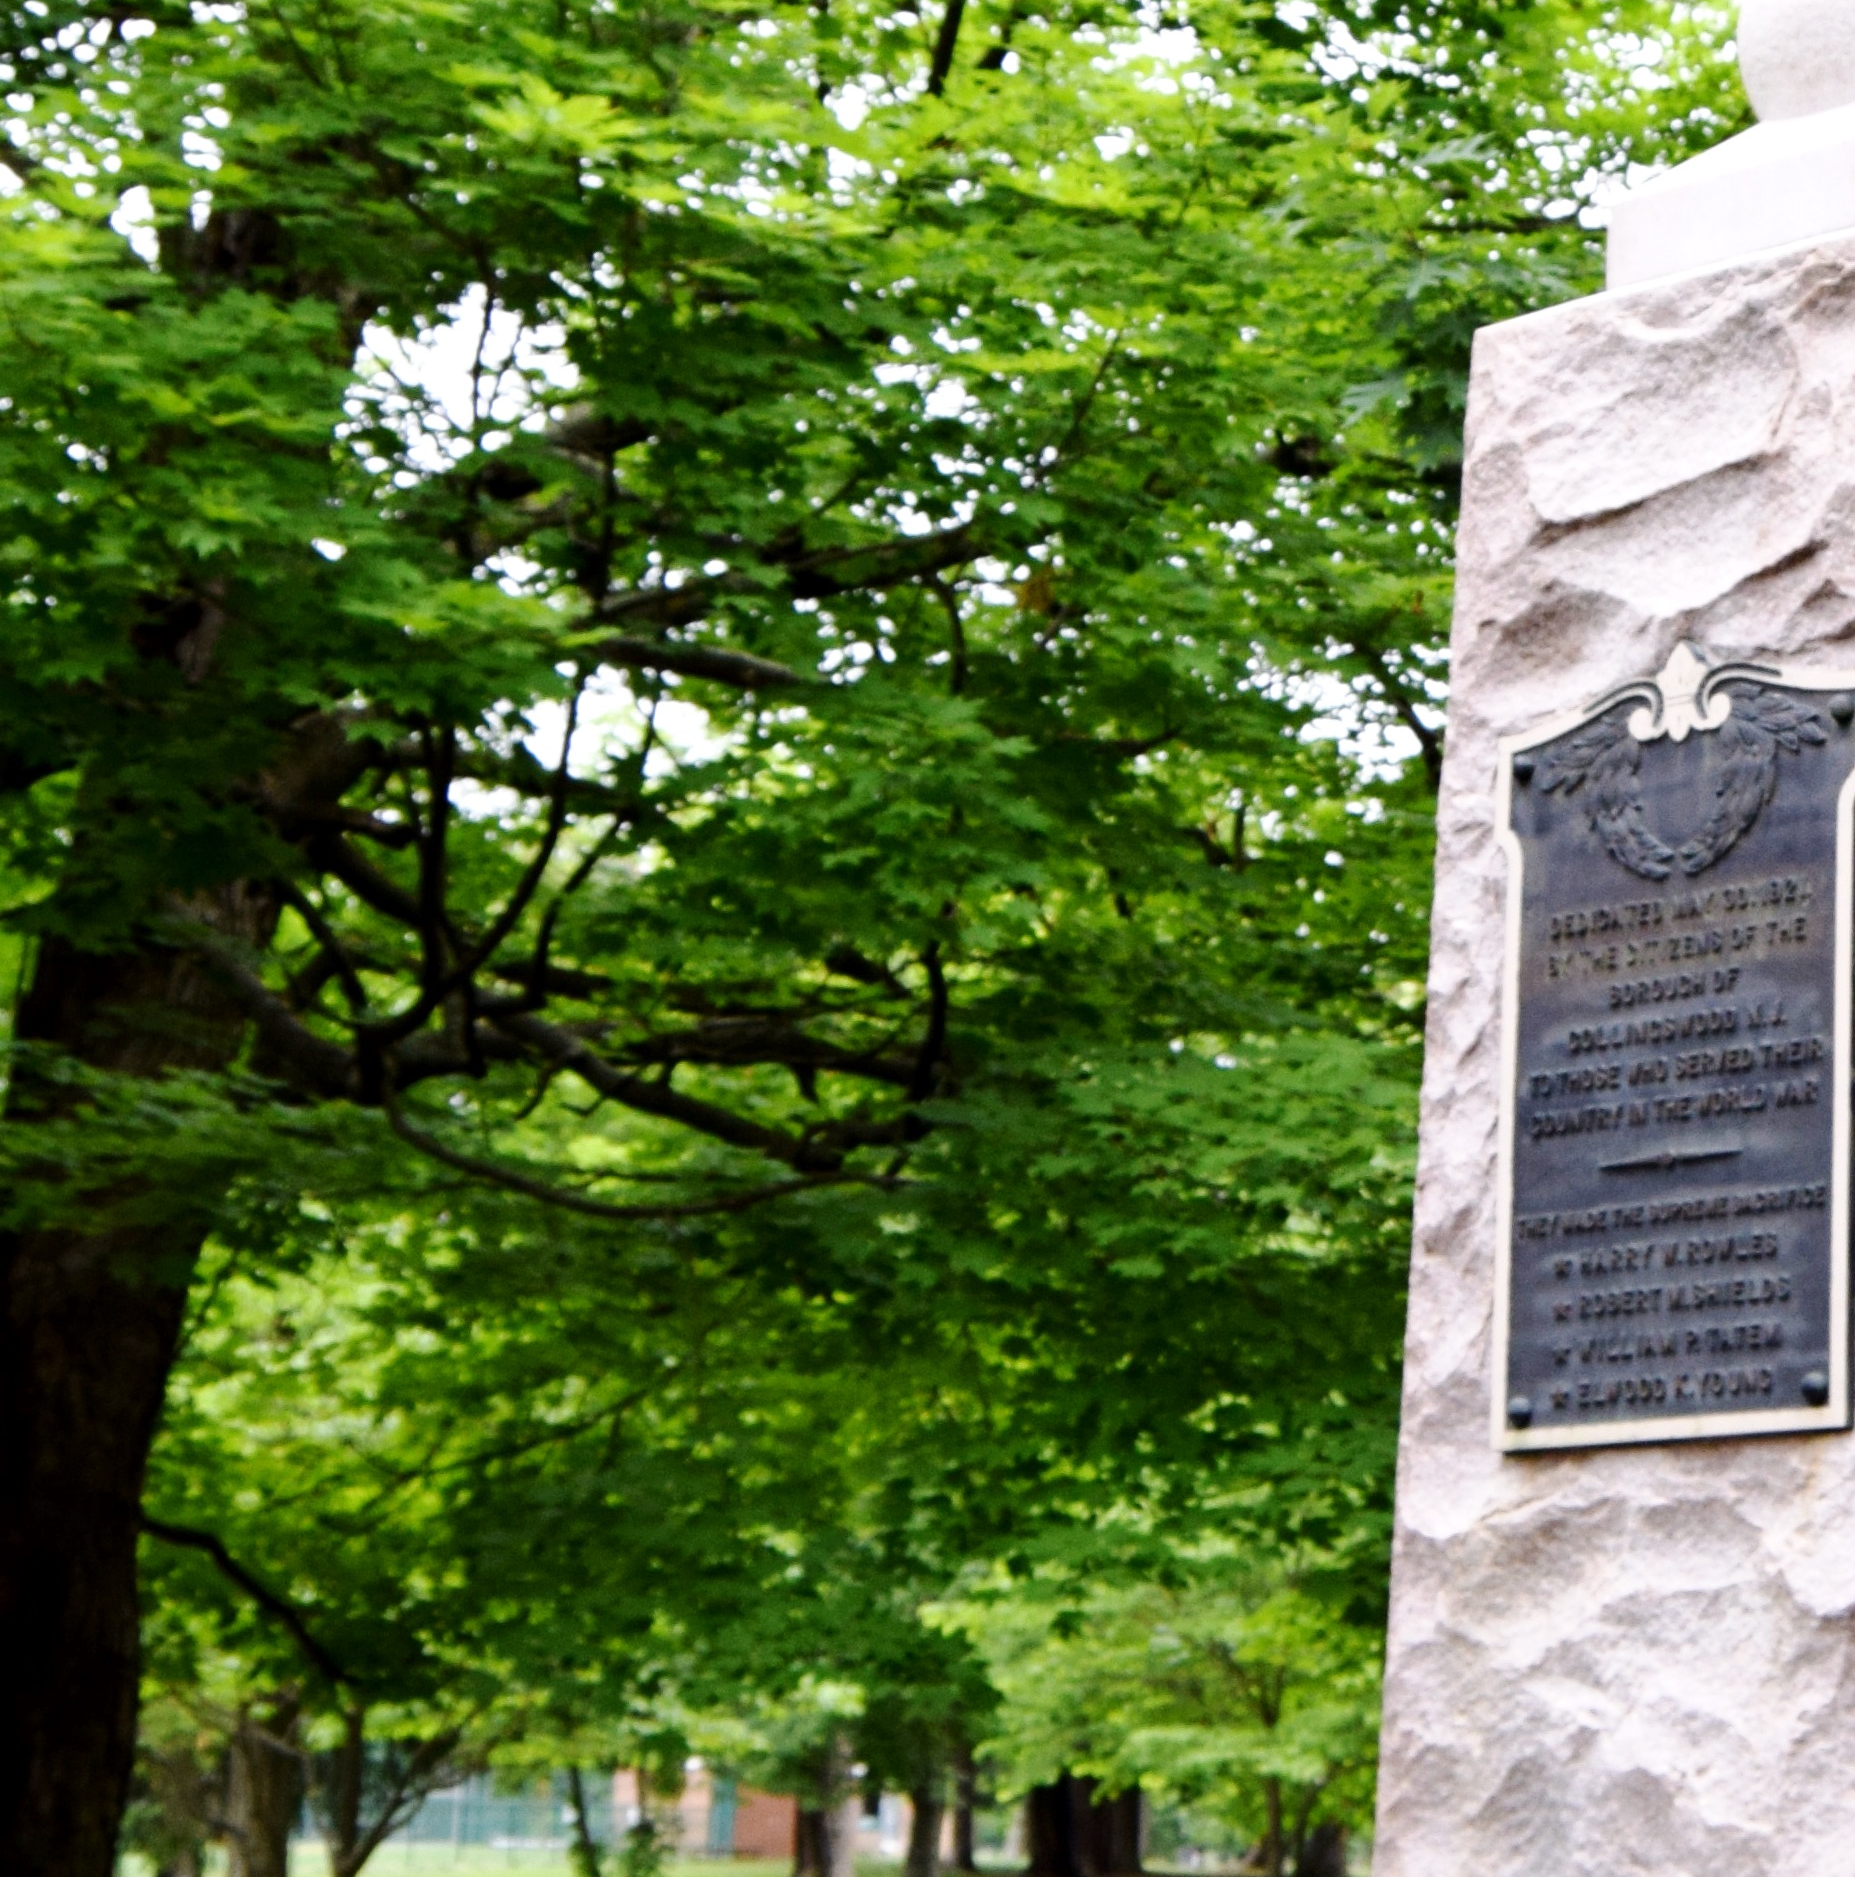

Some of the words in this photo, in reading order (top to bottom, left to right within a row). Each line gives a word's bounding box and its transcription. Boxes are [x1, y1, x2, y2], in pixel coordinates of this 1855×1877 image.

[1731, 923, 1758, 952] OF
[1766, 915, 1808, 947] THE
[1609, 973, 1706, 1011] BOROUGH
[1713, 966, 1742, 996] OF
[1567, 1006, 1738, 1058] COLLINGSWOOD
[1556, 1064, 1621, 1094] THOSE
[1628, 1057, 1669, 1088] WHO
[1675, 1045, 1755, 1083] SERVED
[1759, 1035, 1824, 1070] THEIR
[1529, 1103, 1624, 1143] COUNTRY
[1627, 1100, 1650, 1128] IN
[1653, 1094, 1693, 1124] THE
[1698, 1082, 1768, 1119] WORLD
[1775, 1075, 1820, 1109] WAR
[1611, 1204, 1645, 1230] THE
[1578, 1241, 1656, 1276] HARRY
[1578, 1286, 1662, 1321] ROBERT
[1577, 1377, 1668, 1411] ELWOOD
